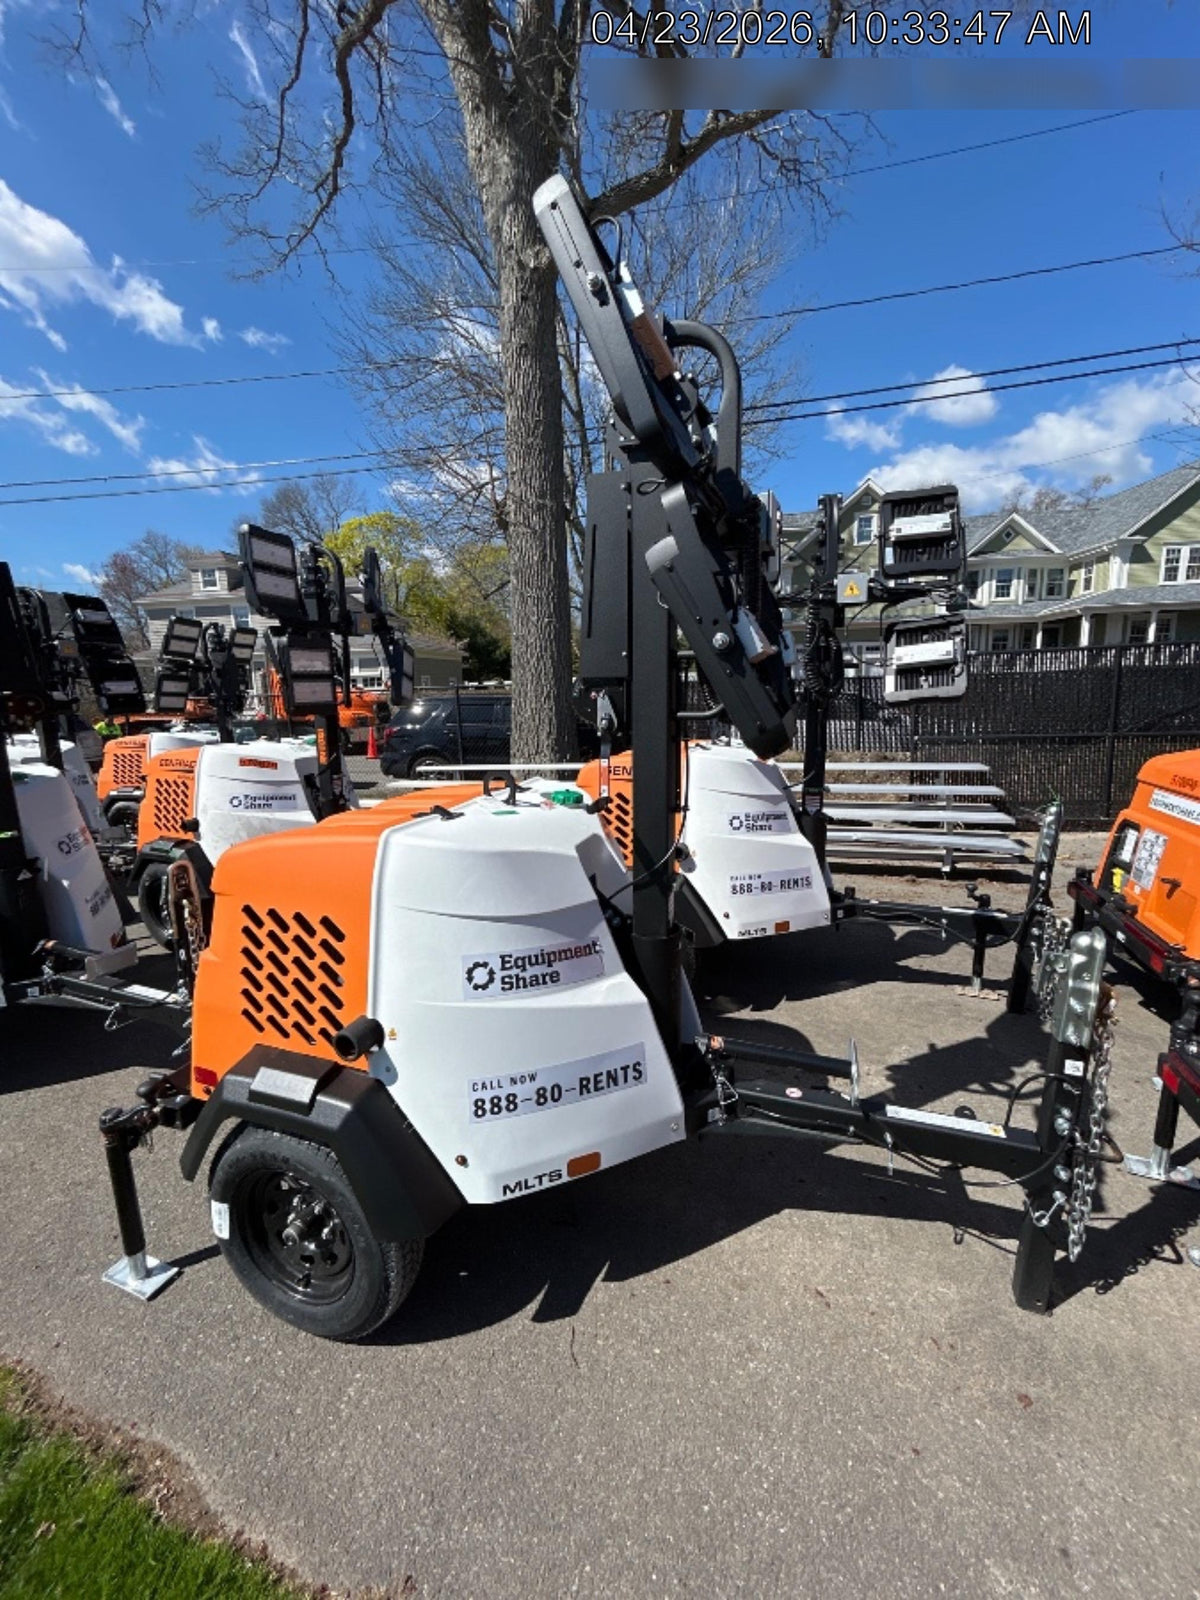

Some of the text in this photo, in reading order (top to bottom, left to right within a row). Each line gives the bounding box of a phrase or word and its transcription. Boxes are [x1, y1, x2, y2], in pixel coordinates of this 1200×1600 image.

[744, 811, 789, 824] Equipment
[744, 821, 773, 832] Share
[499, 940, 600, 972] Equipment
[501, 970, 561, 992] Share
[472, 1072, 538, 1092] CALL NOW
[473, 1061, 643, 1119] 888-80-RENTS
[502, 1169, 563, 1197] MLTS
